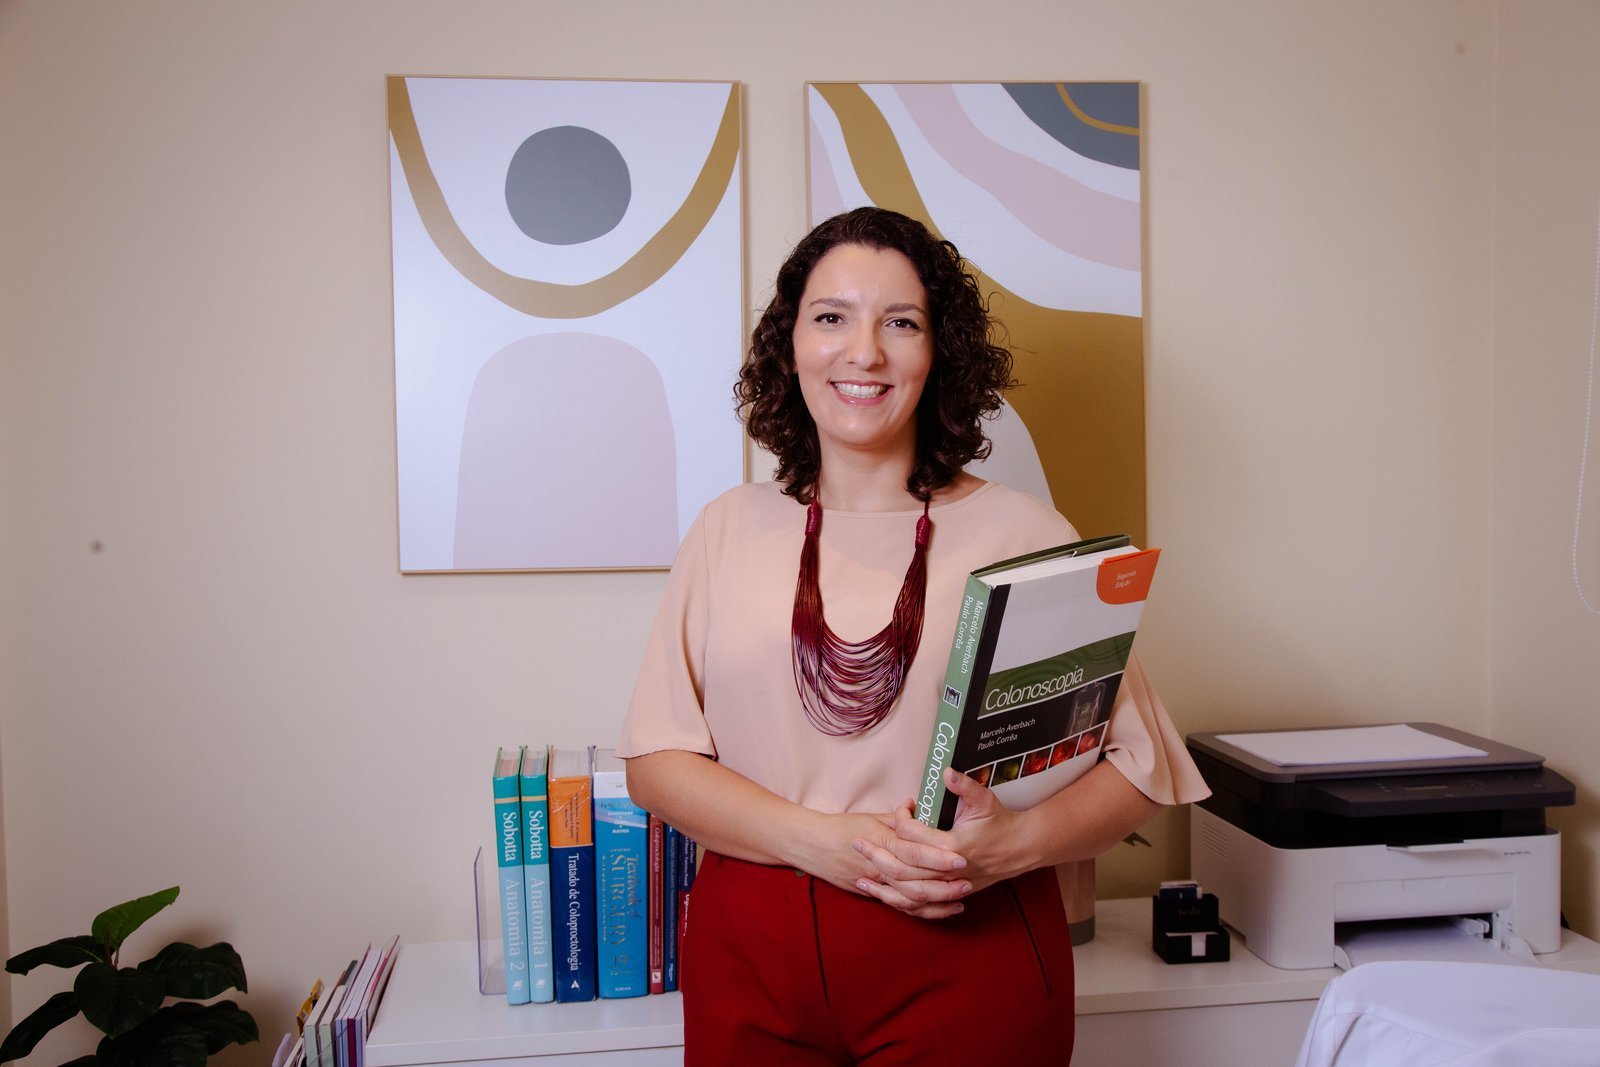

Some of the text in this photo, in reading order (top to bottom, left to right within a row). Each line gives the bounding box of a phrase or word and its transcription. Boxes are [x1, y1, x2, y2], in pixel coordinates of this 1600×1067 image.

[955, 595, 974, 649] Paulo Corrêa
[961, 600, 984, 674] Marcelo Averbach
[985, 665, 1084, 711] Colonoscopia
[977, 733, 1018, 751] Paulo Corrêa
[980, 718, 1036, 740] Marcelo Averbach
[502, 811, 518, 862] Sobotta
[528, 810, 545, 860] Sobotta
[568, 852, 580, 887] Tratado
[568, 889, 578, 900] de
[505, 879, 525, 971] Anatomia 2
[531, 877, 548, 955] Anatomia
[566, 901, 582, 971] Coloproctologia
